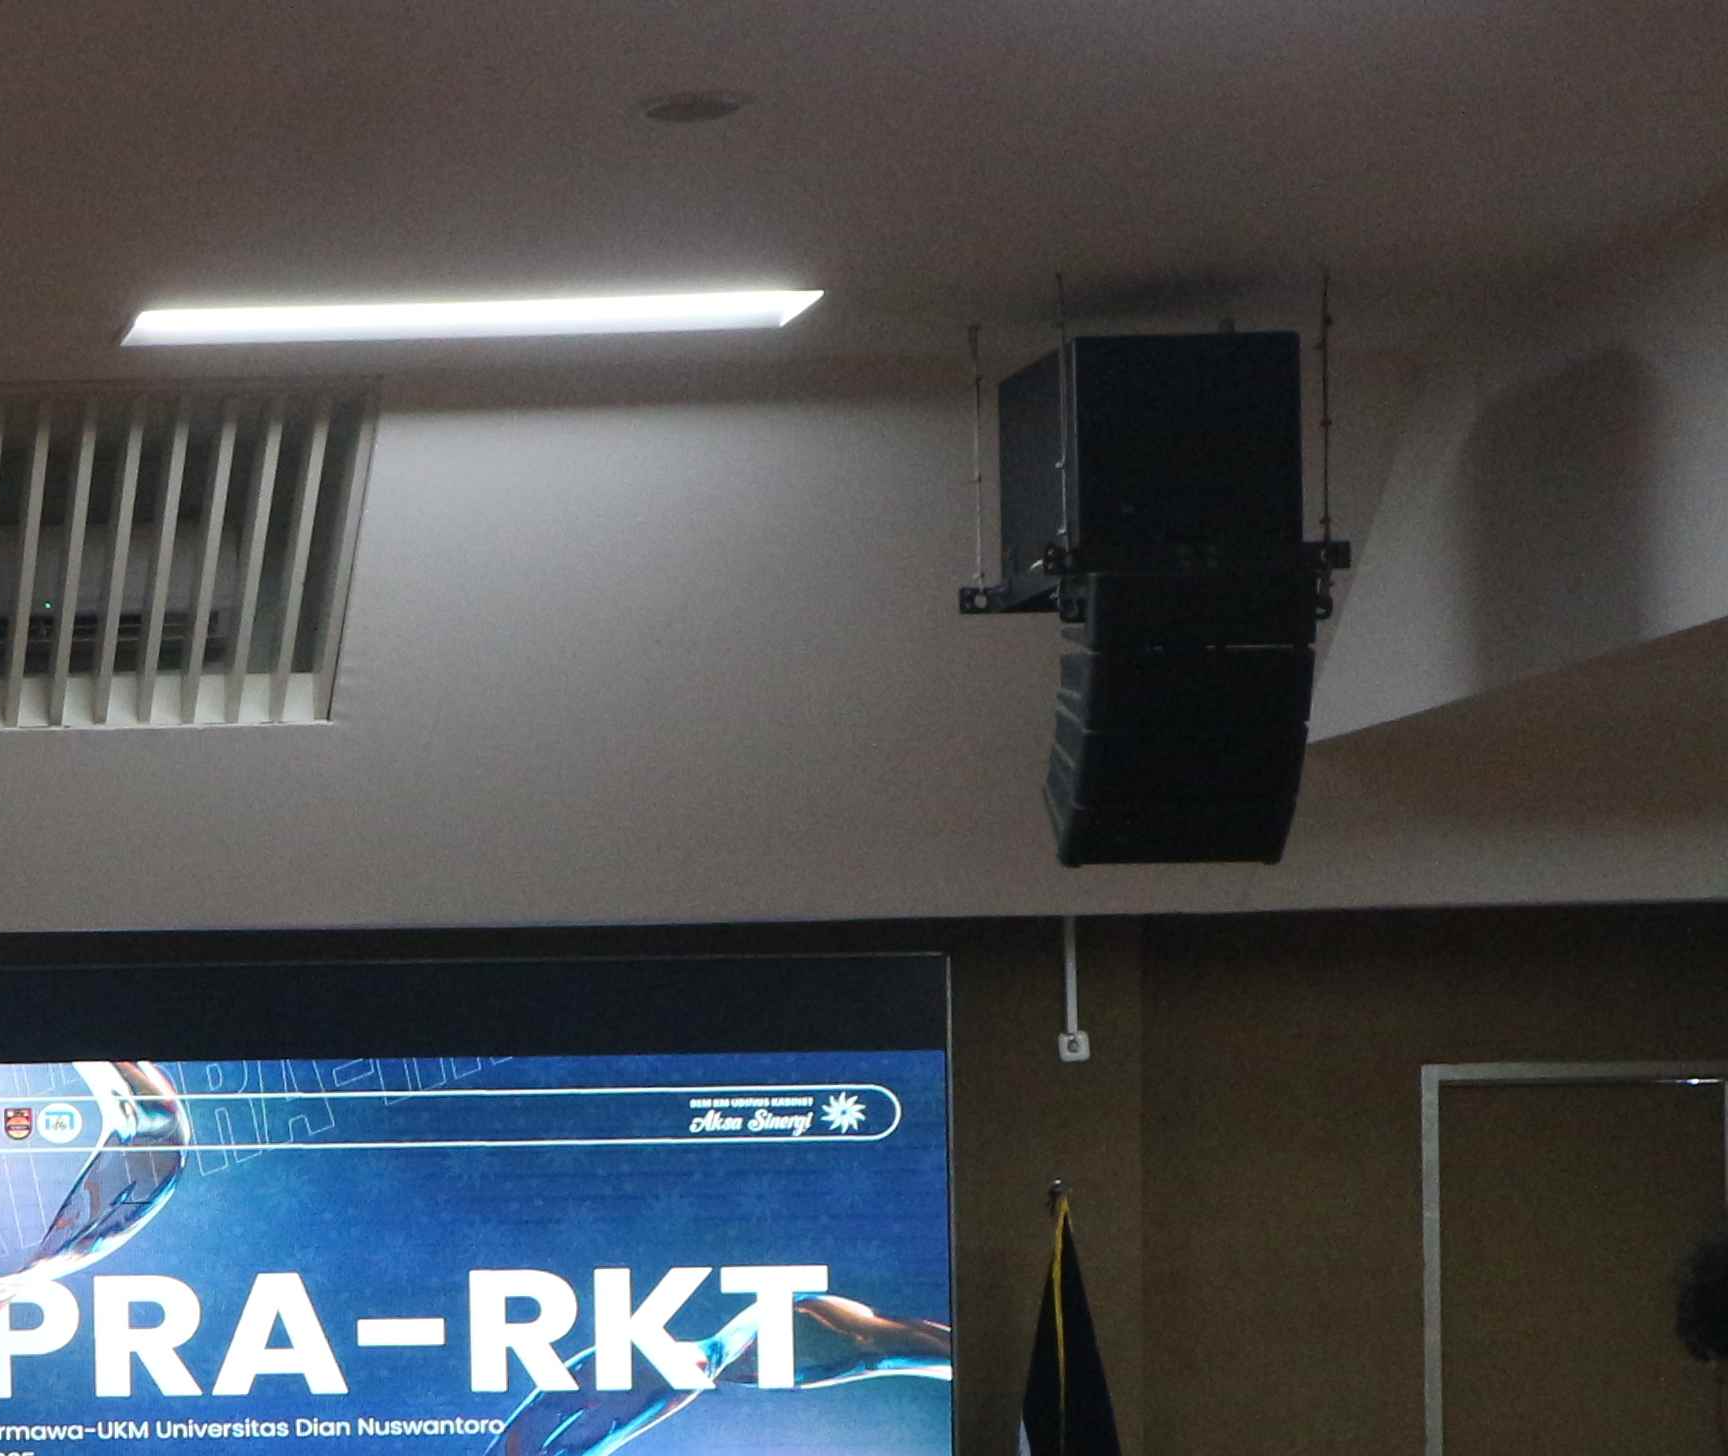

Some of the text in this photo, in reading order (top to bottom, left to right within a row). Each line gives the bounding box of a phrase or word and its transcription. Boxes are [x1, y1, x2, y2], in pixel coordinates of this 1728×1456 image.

[688, 1108, 814, 1137] Aksa Sinergi
[156, 1418, 290, 1440] Universitas
[295, 1417, 352, 1438] Dian
[357, 1416, 506, 1438] Nuswantoro
